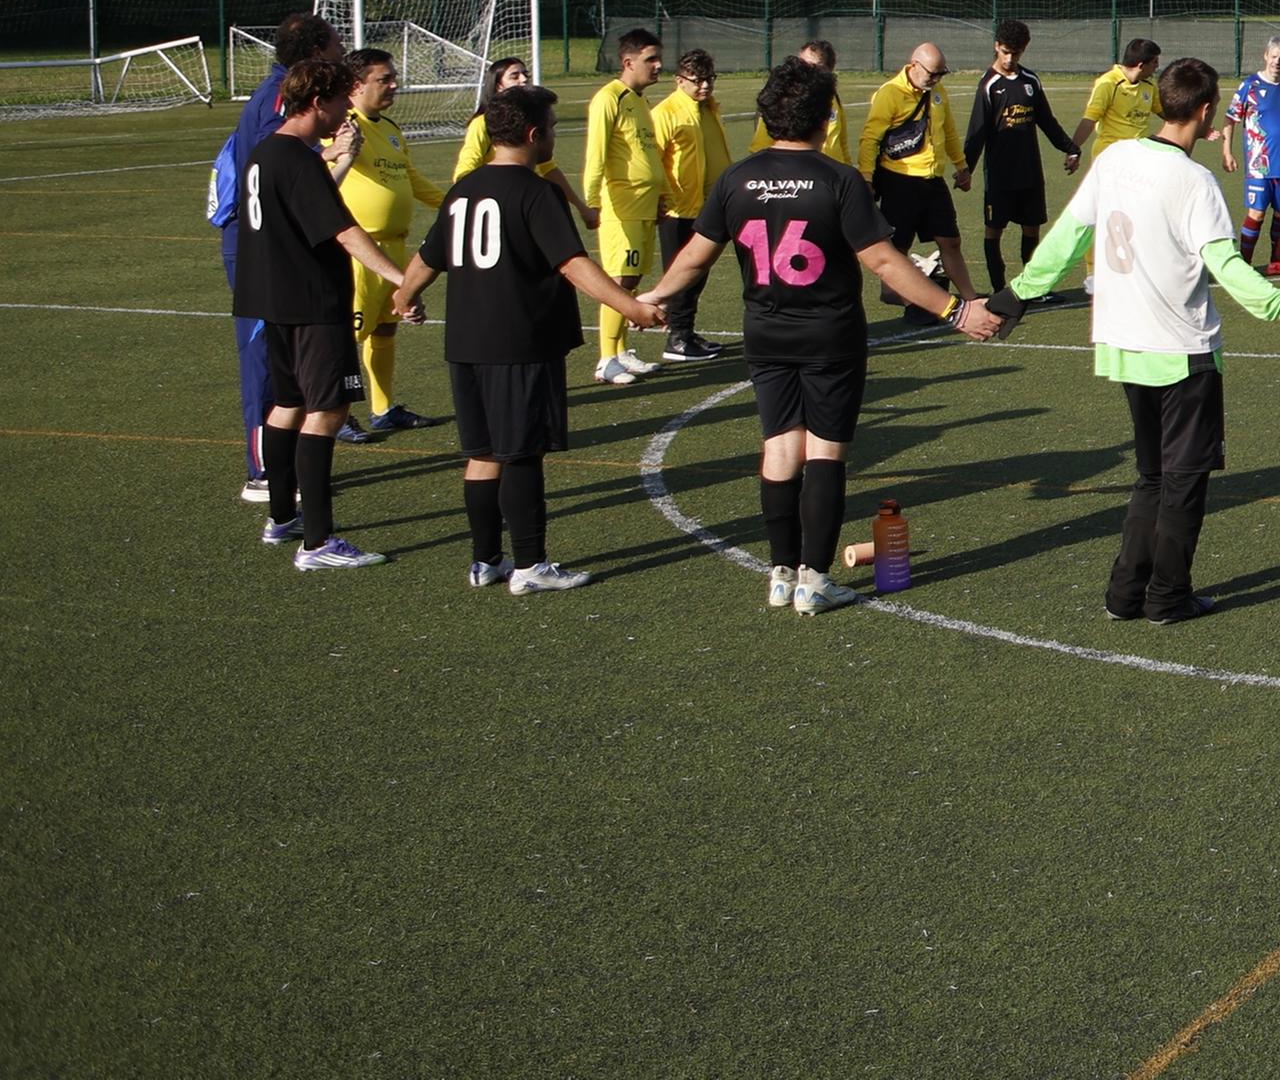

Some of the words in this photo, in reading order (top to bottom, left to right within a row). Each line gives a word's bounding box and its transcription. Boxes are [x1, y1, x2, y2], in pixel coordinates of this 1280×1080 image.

[248, 163, 262, 231] 8
[745, 180, 814, 190] GALVANI
[757, 188, 799, 203] Special
[449, 197, 501, 269] 10
[625, 250, 640, 267] 10
[738, 219, 826, 286] 16
[1105, 210, 1135, 274] 8
